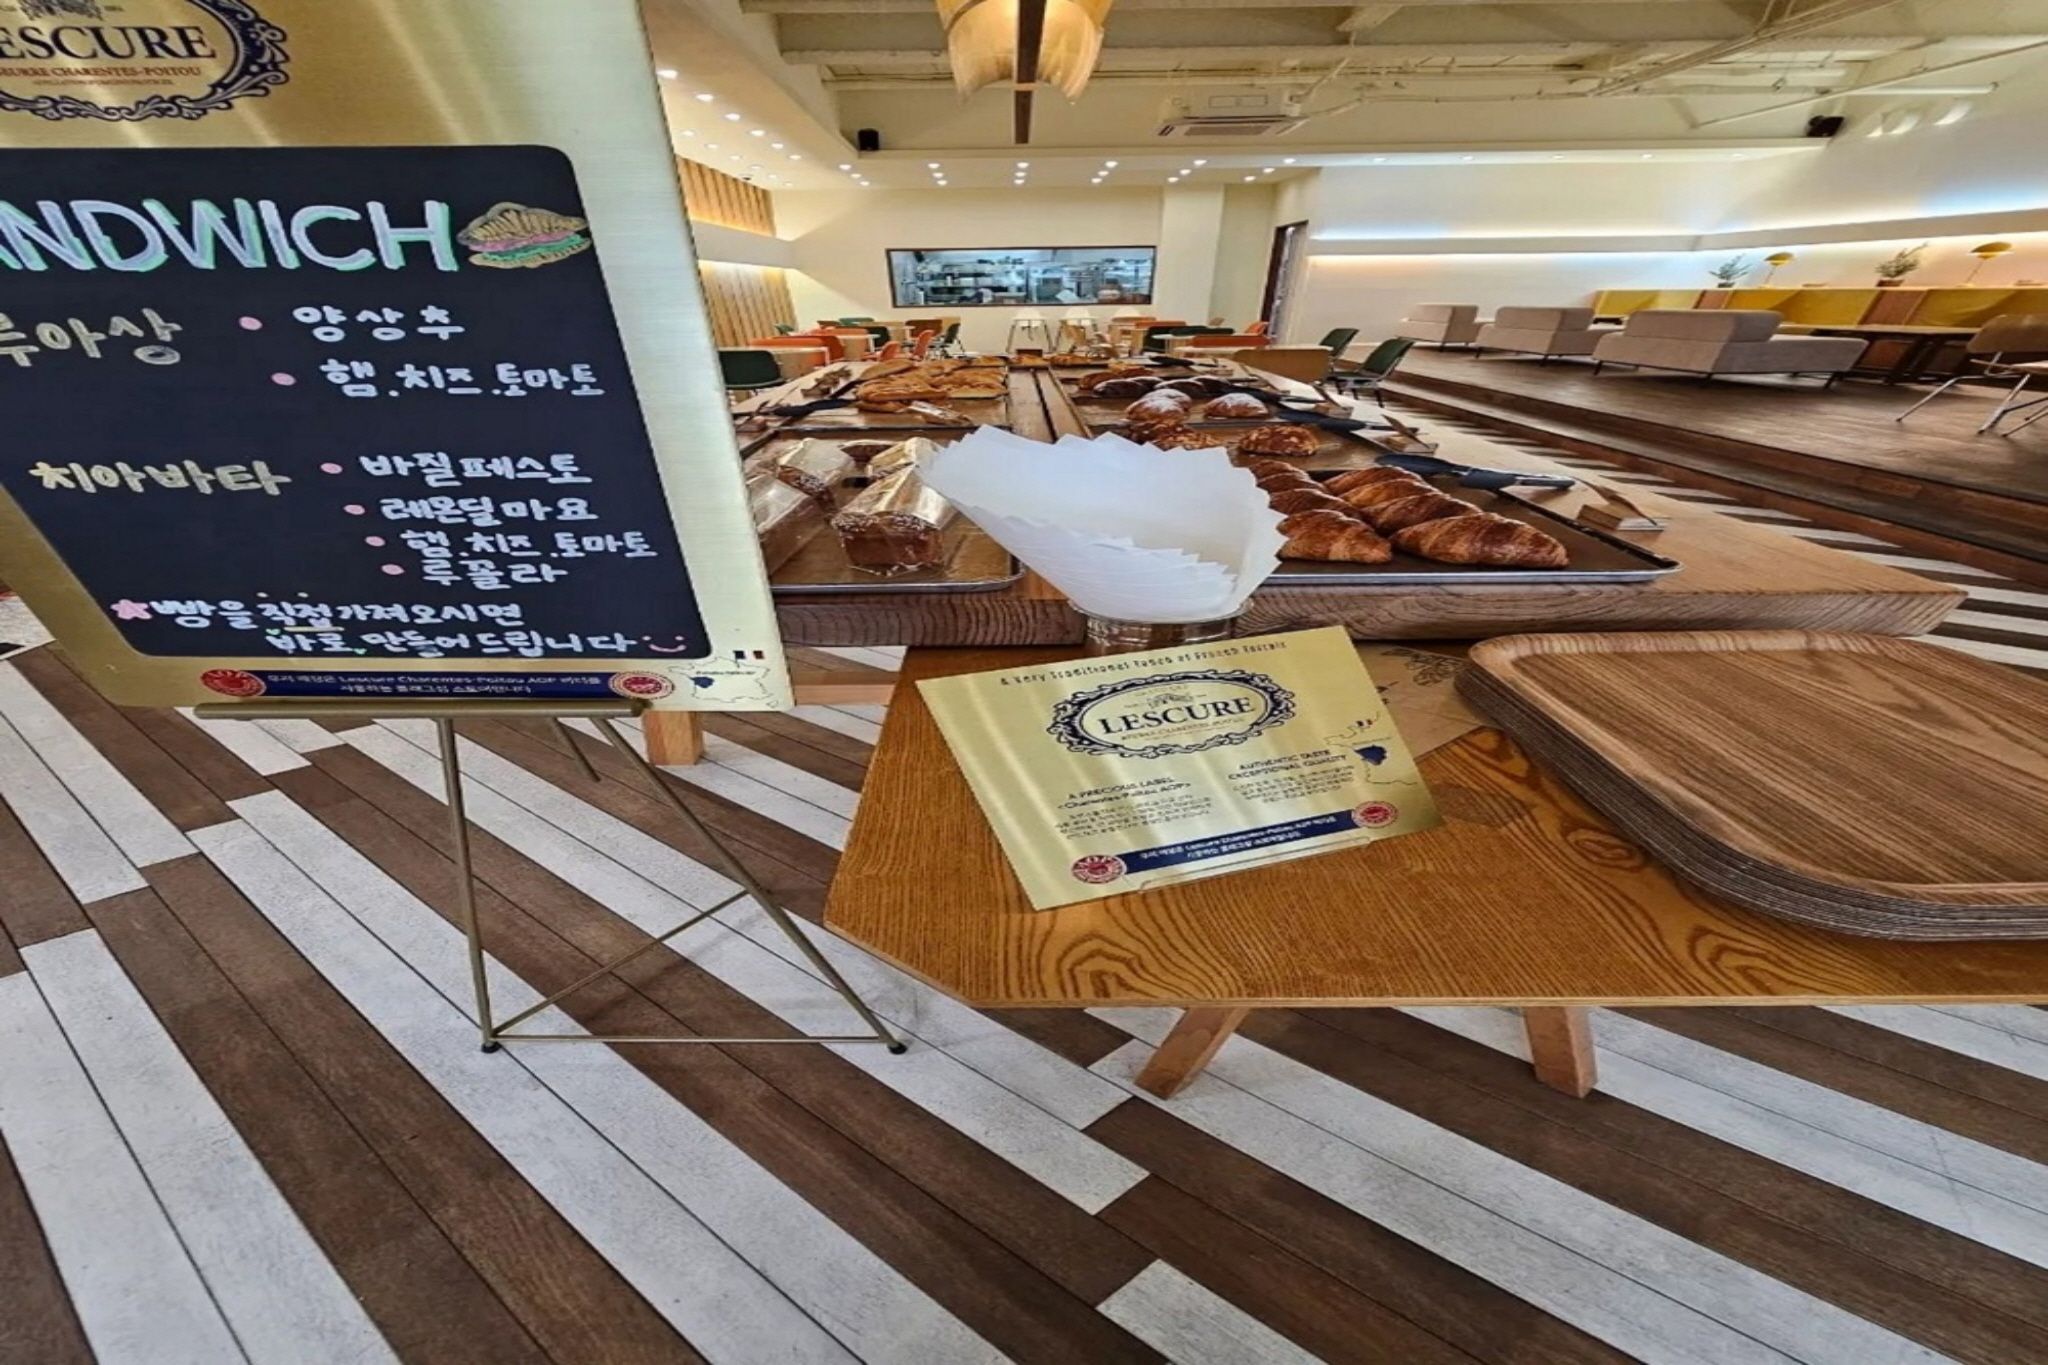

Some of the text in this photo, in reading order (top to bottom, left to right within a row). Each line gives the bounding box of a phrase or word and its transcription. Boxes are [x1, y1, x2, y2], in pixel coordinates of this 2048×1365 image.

[292, 305, 465, 342] 양상추
[28, 459, 292, 496] 치아바타
[420, 558, 569, 590] 루꼴라
[265, 632, 353, 654] 바로
[1012, 673, 1047, 683] Very
[1096, 696, 1257, 733] LESCURE
[1226, 754, 1349, 779] EXCEPTIONAL QUALITY
[1237, 749, 1331, 769] AUTHENTIC TASTE
[1077, 783, 1138, 797] PRECIOUS
[1138, 777, 1174, 786] LABEL
